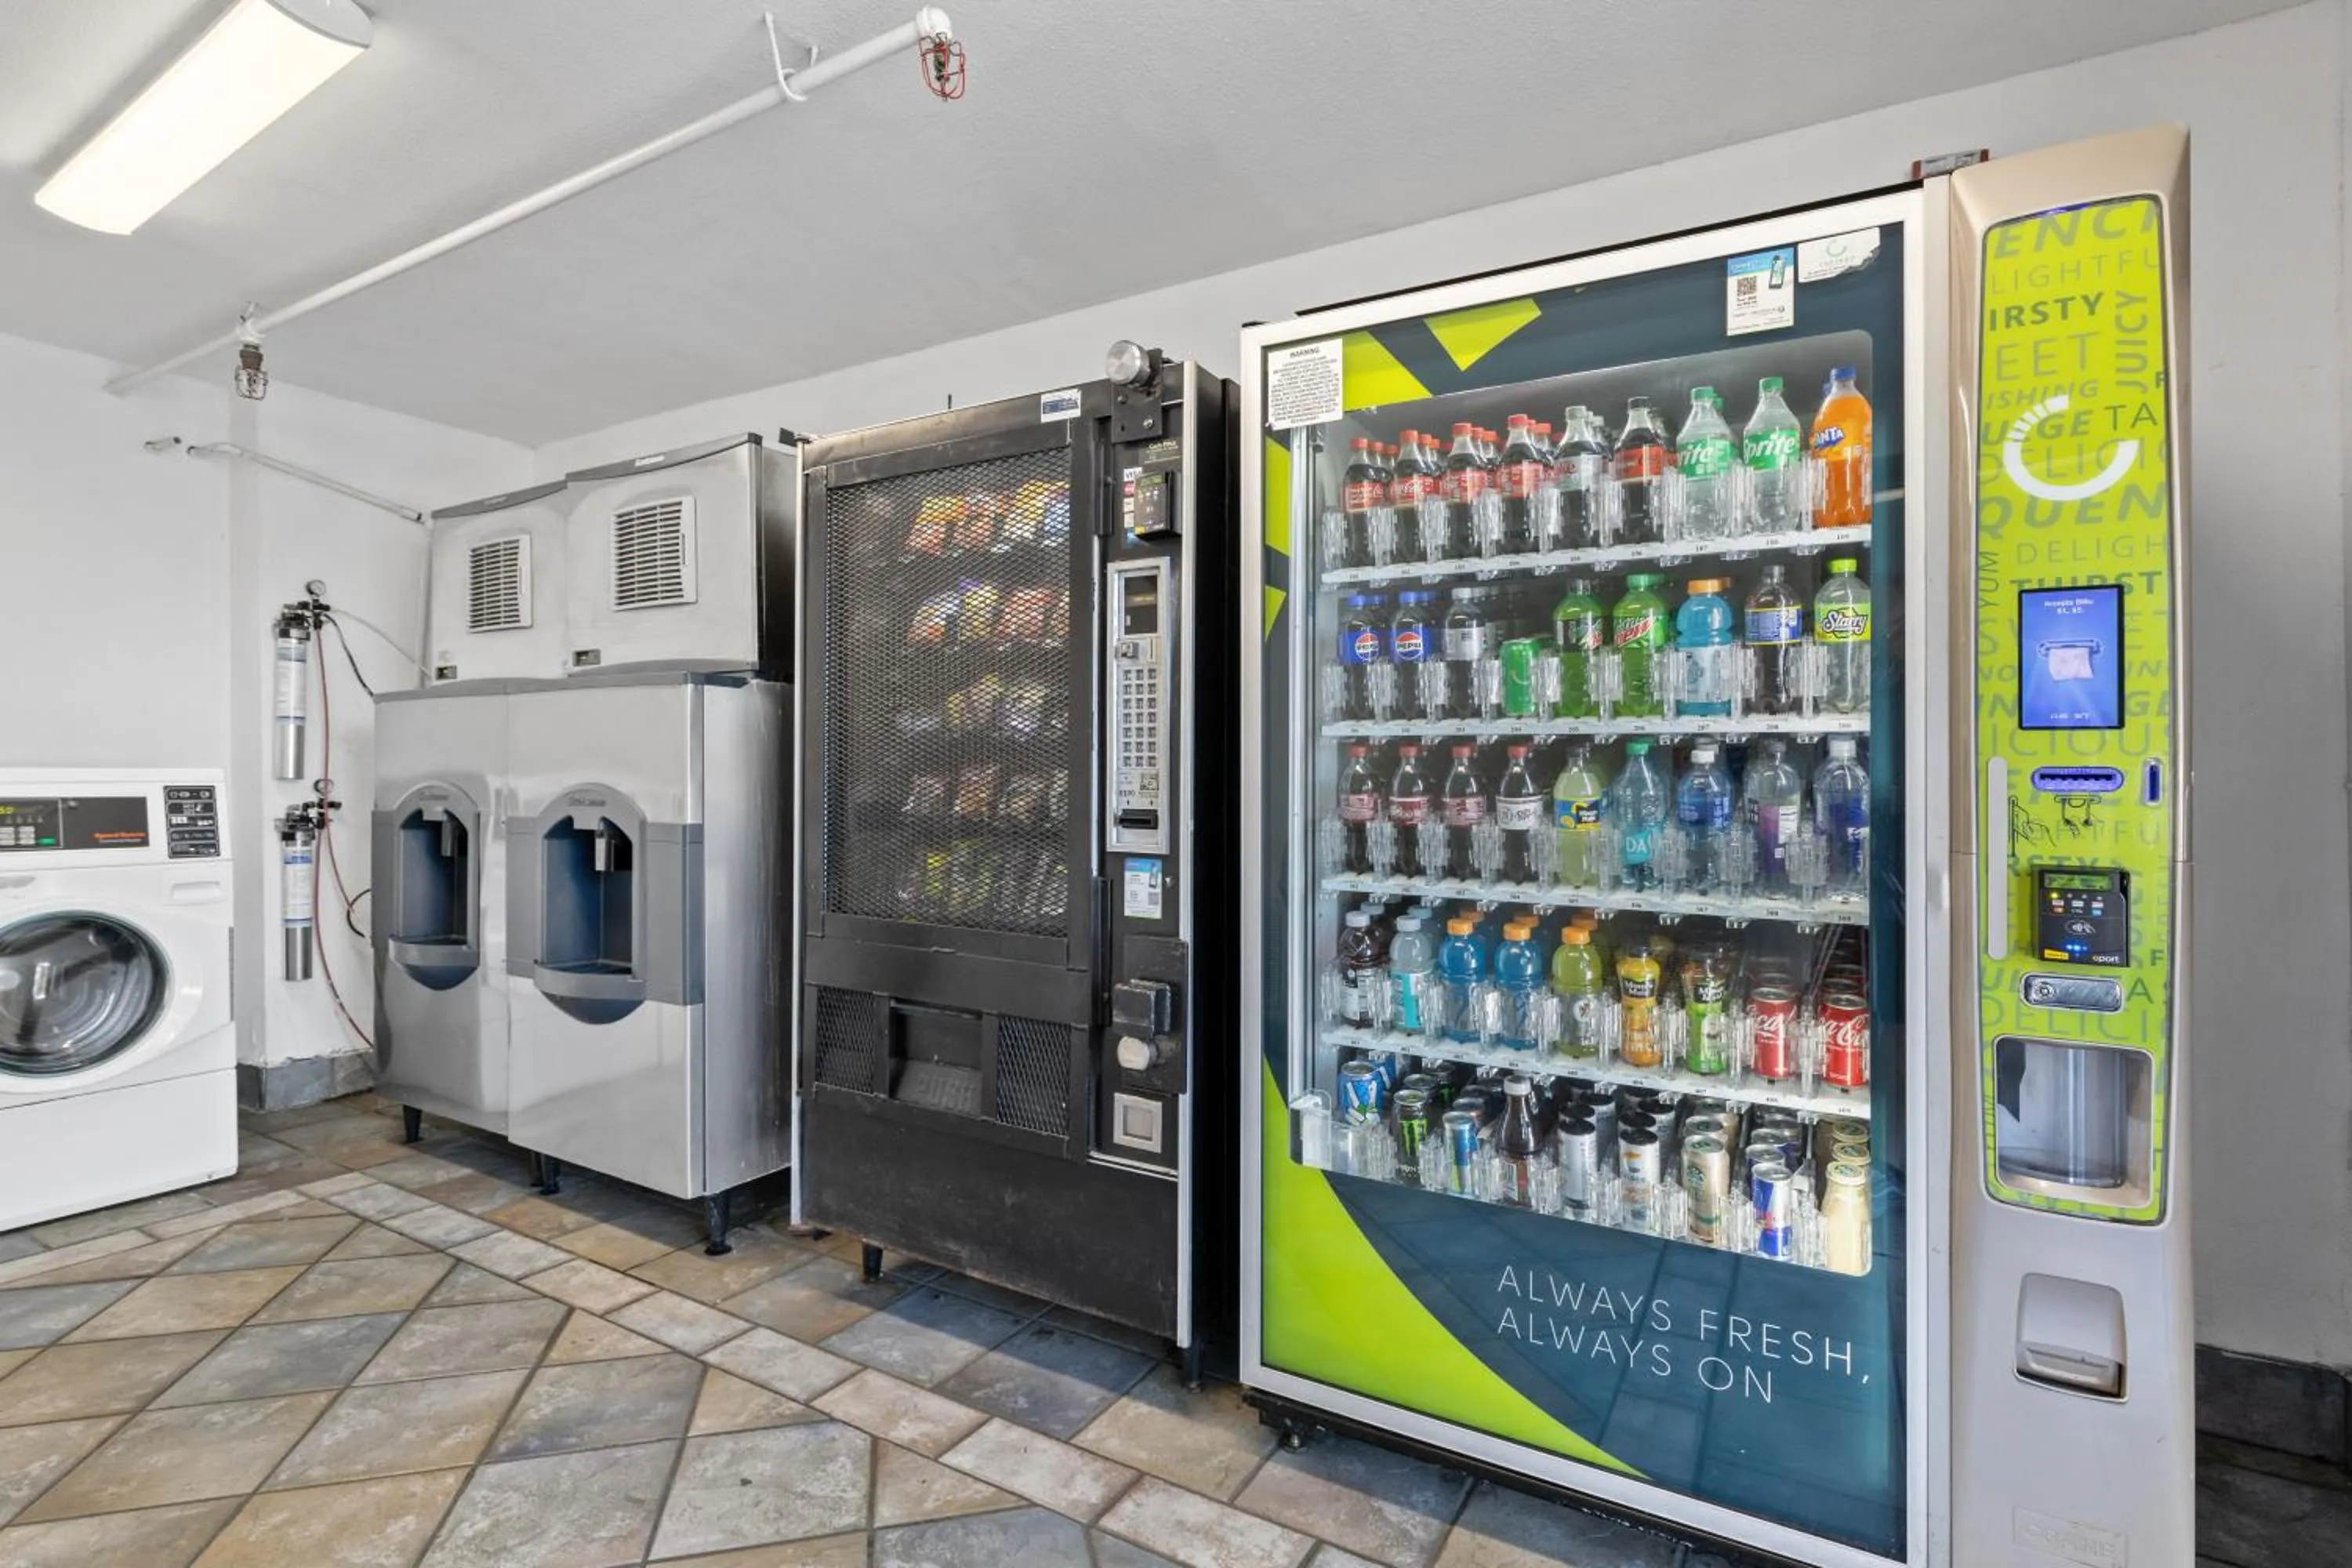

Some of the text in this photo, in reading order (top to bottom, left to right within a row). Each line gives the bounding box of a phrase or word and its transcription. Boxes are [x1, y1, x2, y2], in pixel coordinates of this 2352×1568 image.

[2114, 289, 2148, 394] JUICY
[1744, 426, 1795, 464] Sprite
[1497, 1265, 1870, 1385] ALWAYS FRESH,
[1497, 1306, 1772, 1403] ALWAYS ON
